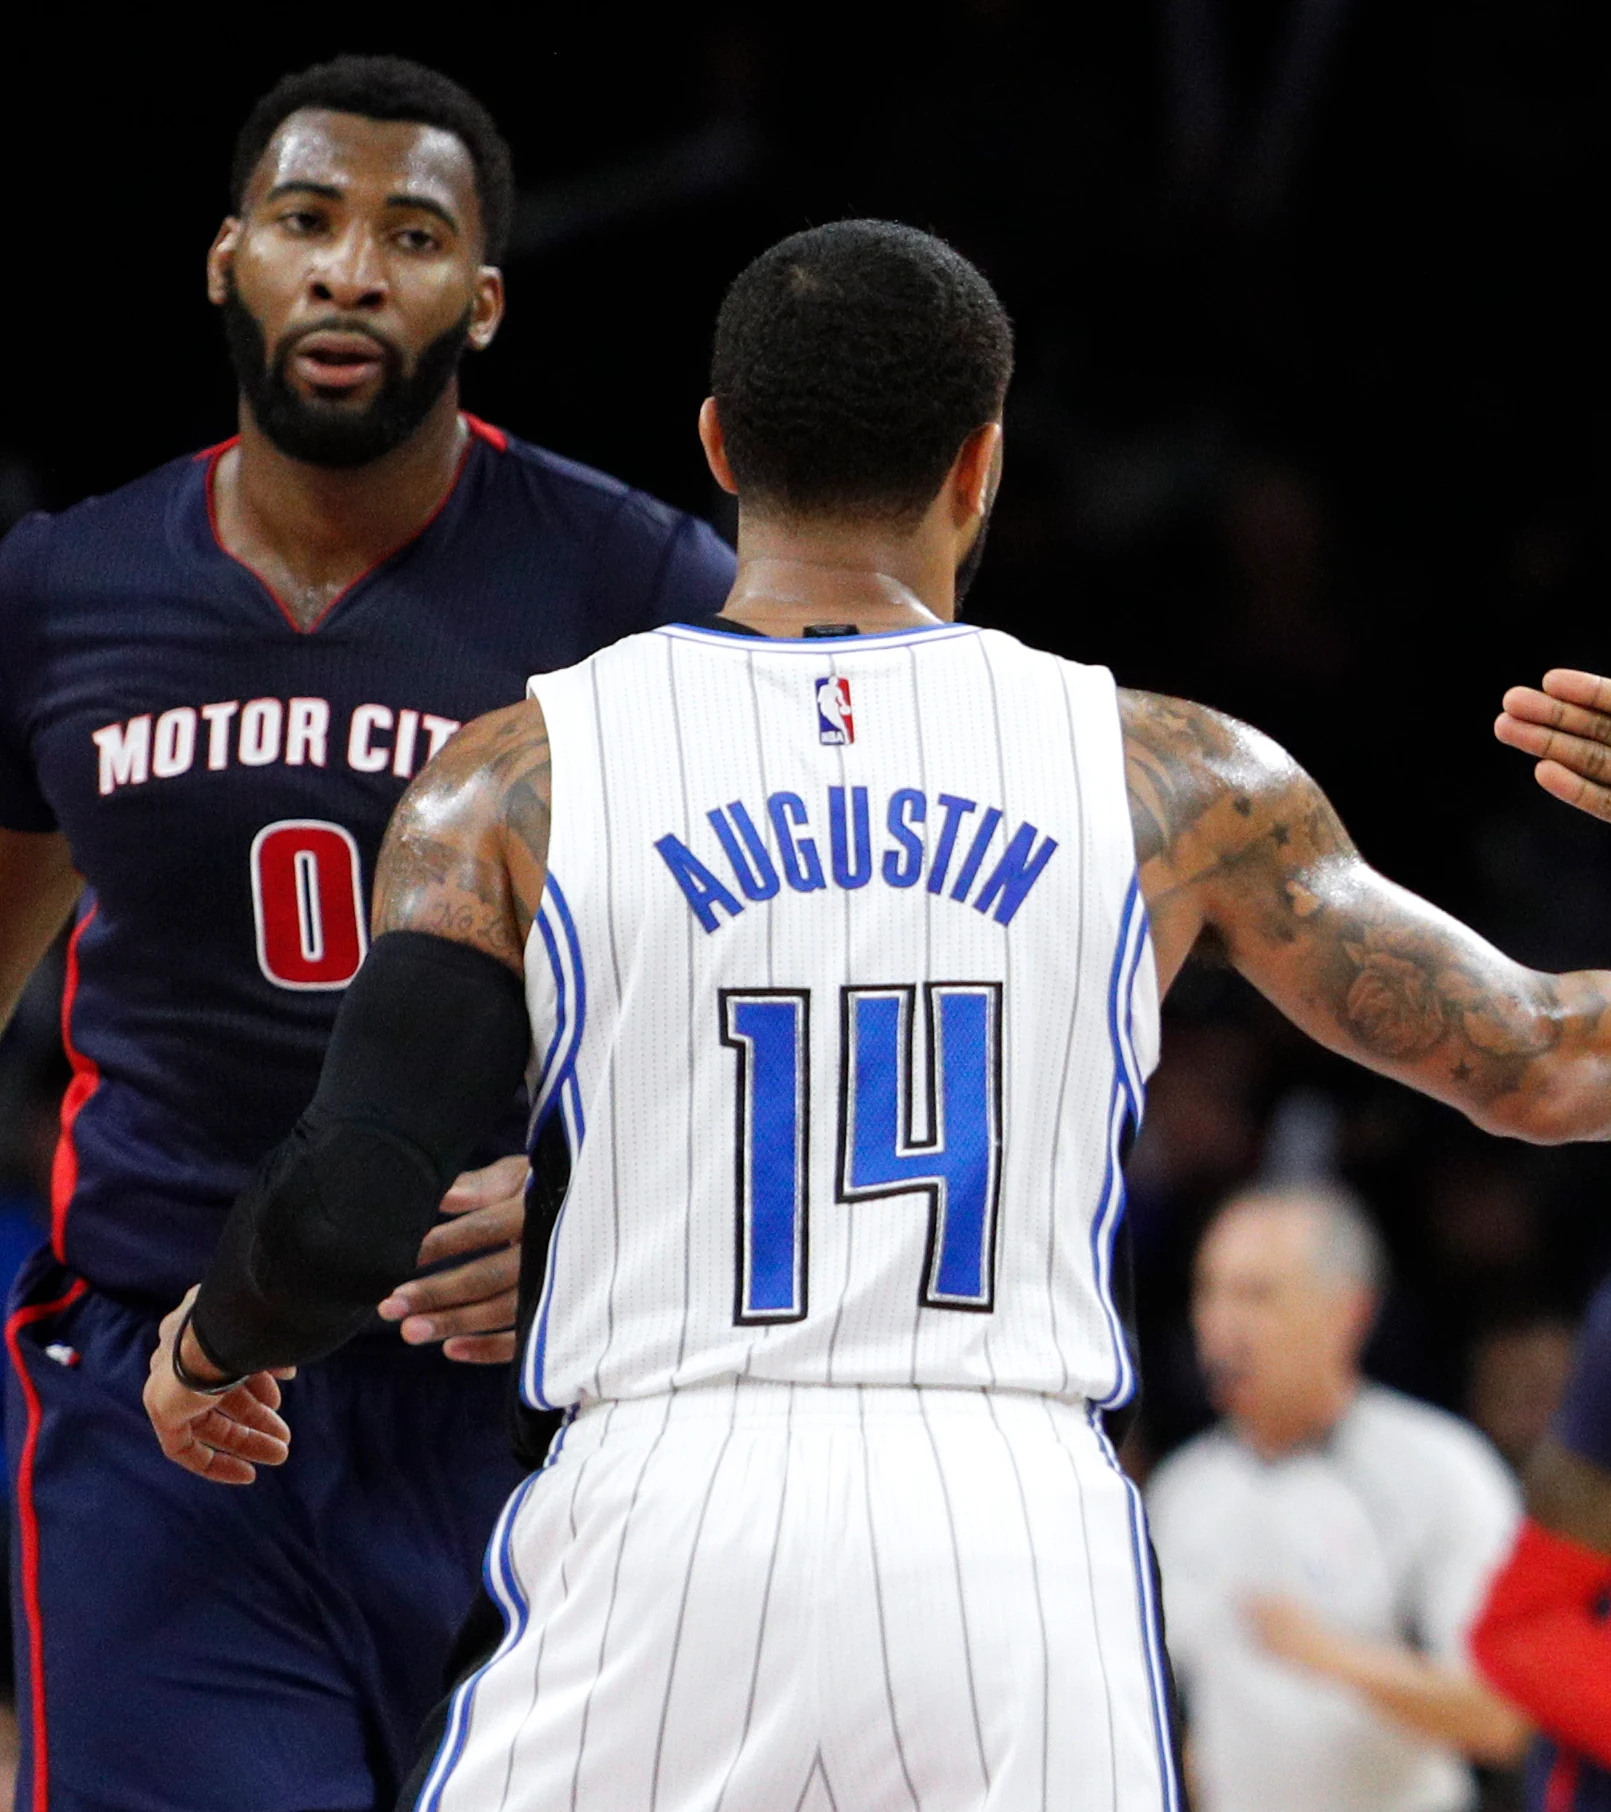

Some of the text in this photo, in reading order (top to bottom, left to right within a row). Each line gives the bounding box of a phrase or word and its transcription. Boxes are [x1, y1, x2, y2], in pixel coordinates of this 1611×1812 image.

[93, 698, 461, 794] MOTOR CIT
[250, 818, 367, 990] 0
[653, 785, 1059, 934] AUGUSTIN
[718, 981, 1003, 1326] 14
